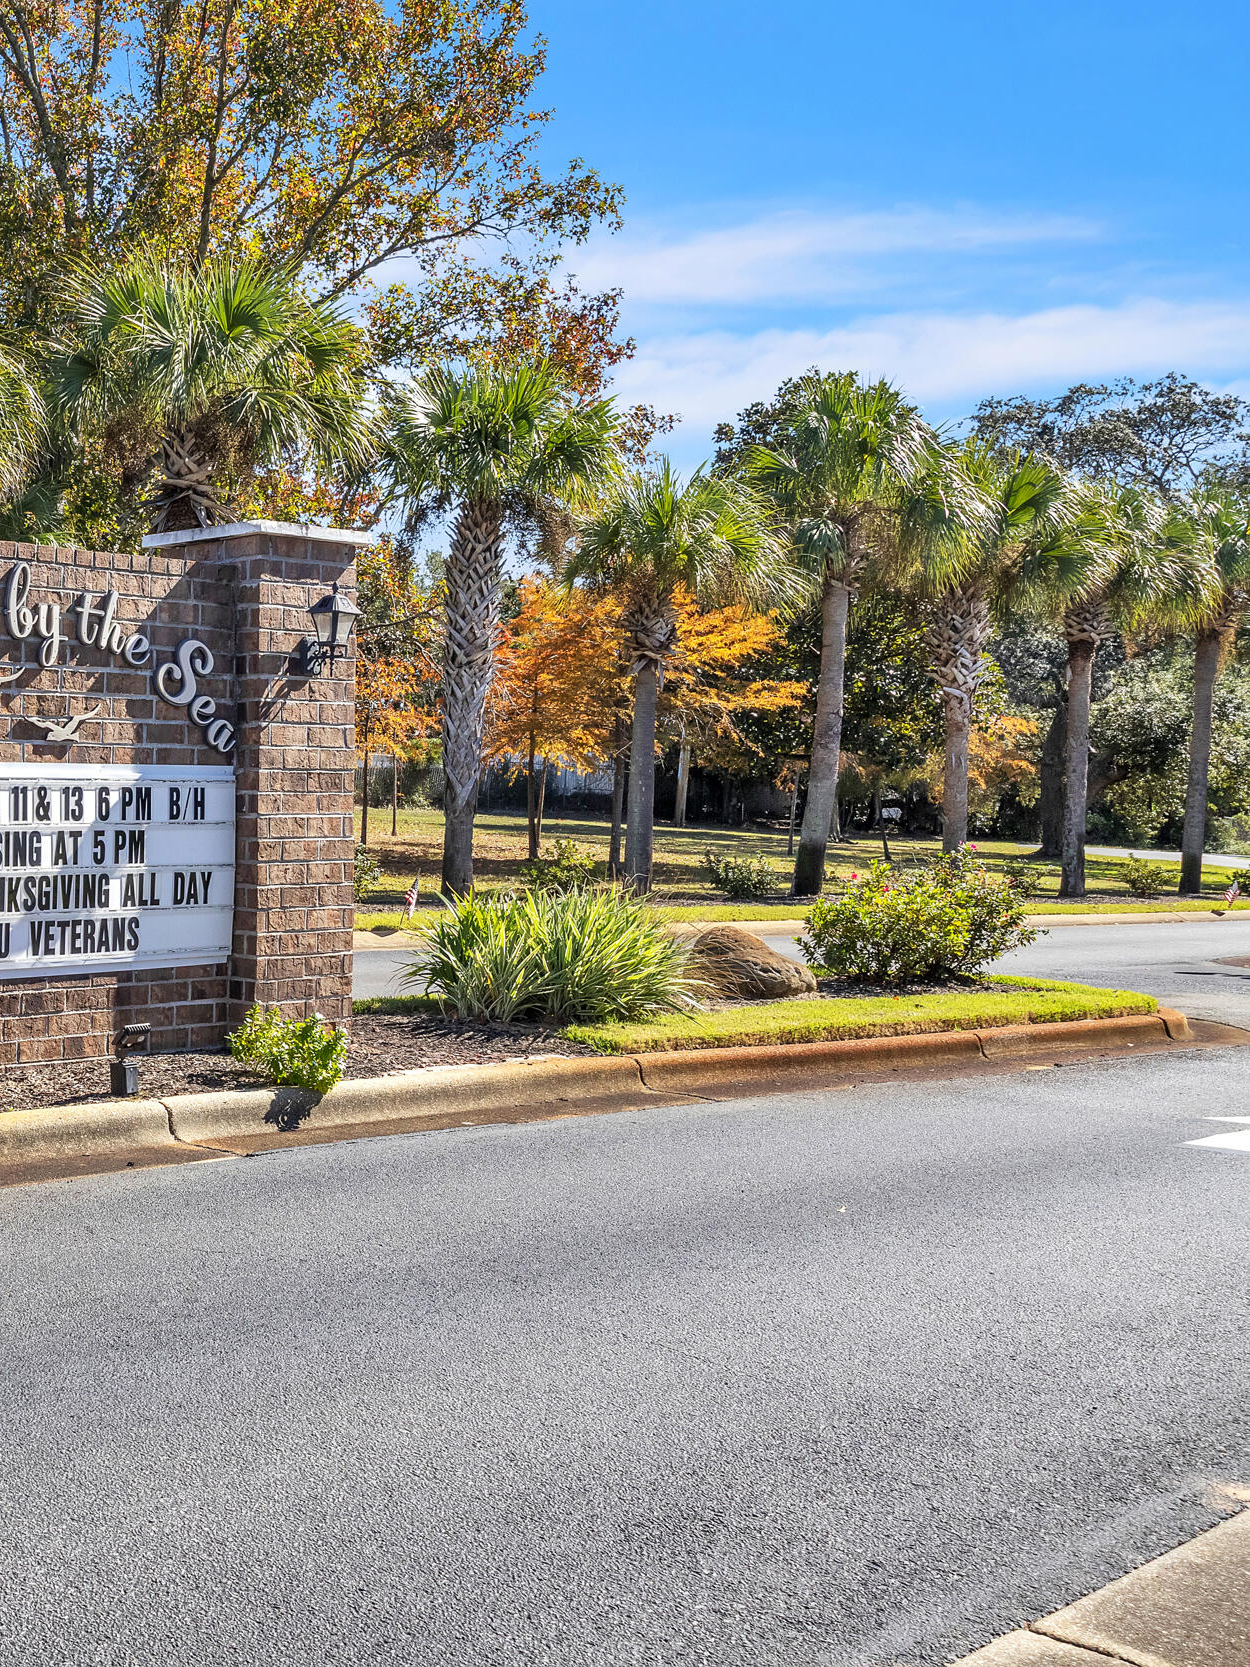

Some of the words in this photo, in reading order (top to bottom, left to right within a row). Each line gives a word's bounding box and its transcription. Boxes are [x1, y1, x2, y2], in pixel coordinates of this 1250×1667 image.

[5, 561, 68, 668] by
[75, 590, 150, 667] the
[153, 638, 236, 754] Sea
[63, 786, 84, 822] 13
[97, 786, 110, 822] 6
[122, 786, 152, 821] PM
[169, 787, 205, 821] B/H
[53, 830, 83, 866] AT
[93, 830, 105, 865] 5
[114, 829, 146, 865] PM
[122, 872, 160, 908] ALL
[173, 871, 212, 905] DAY
[30, 917, 139, 957] VETERANS
